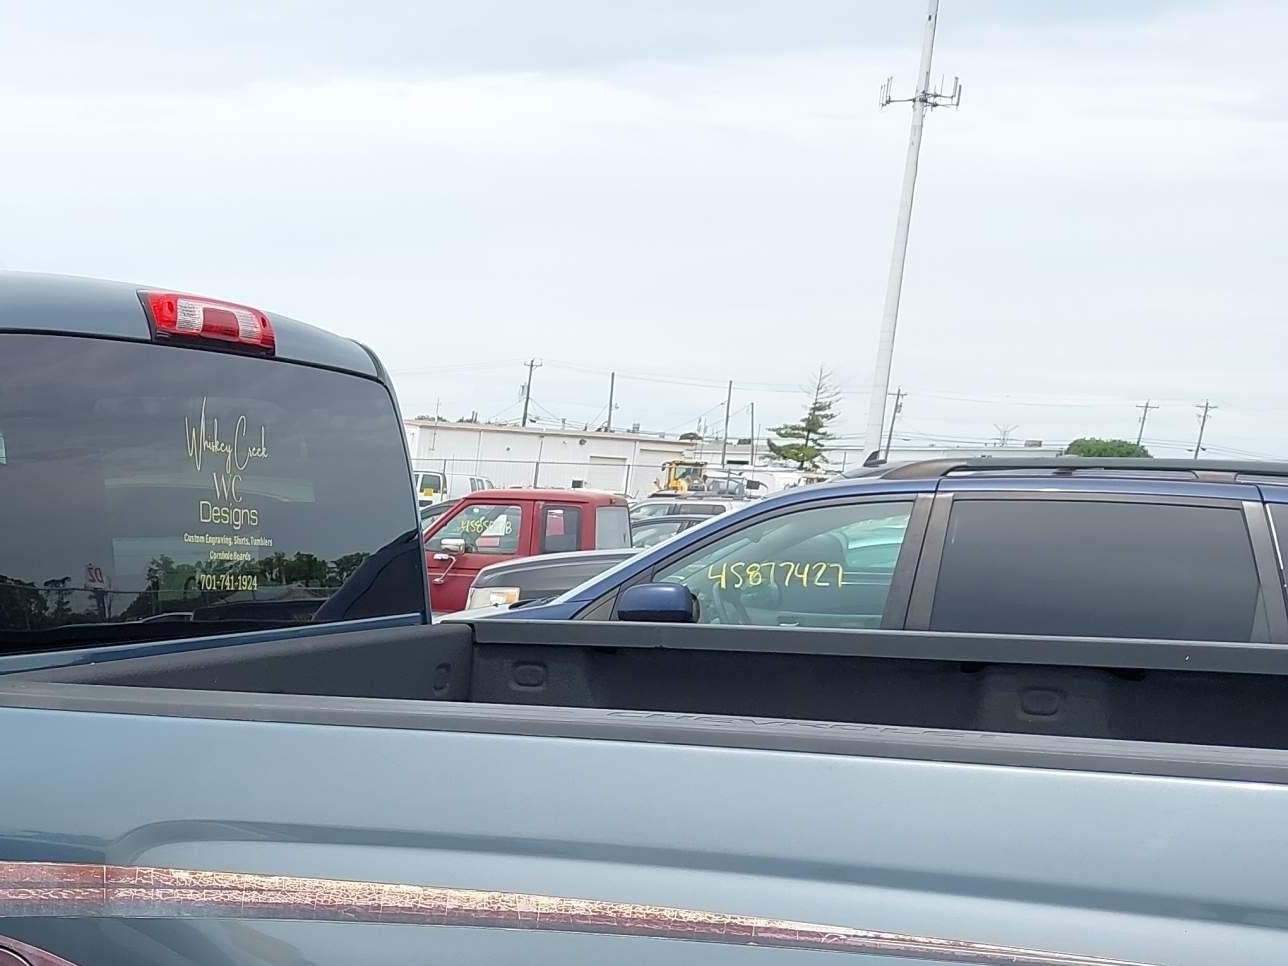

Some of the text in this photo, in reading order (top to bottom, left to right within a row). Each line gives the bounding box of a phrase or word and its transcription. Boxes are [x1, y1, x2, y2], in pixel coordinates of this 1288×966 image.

[185, 396, 269, 474] Whiskey Creek
[213, 472, 242, 502] WC
[199, 500, 259, 530] Designs
[184, 533, 205, 543] Custom
[251, 537, 273, 547] Tumblers
[209, 551, 251, 561] Cornhole Boards
[200, 574, 258, 591] 701-741-1924
[708, 562, 844, 589] 45877427
